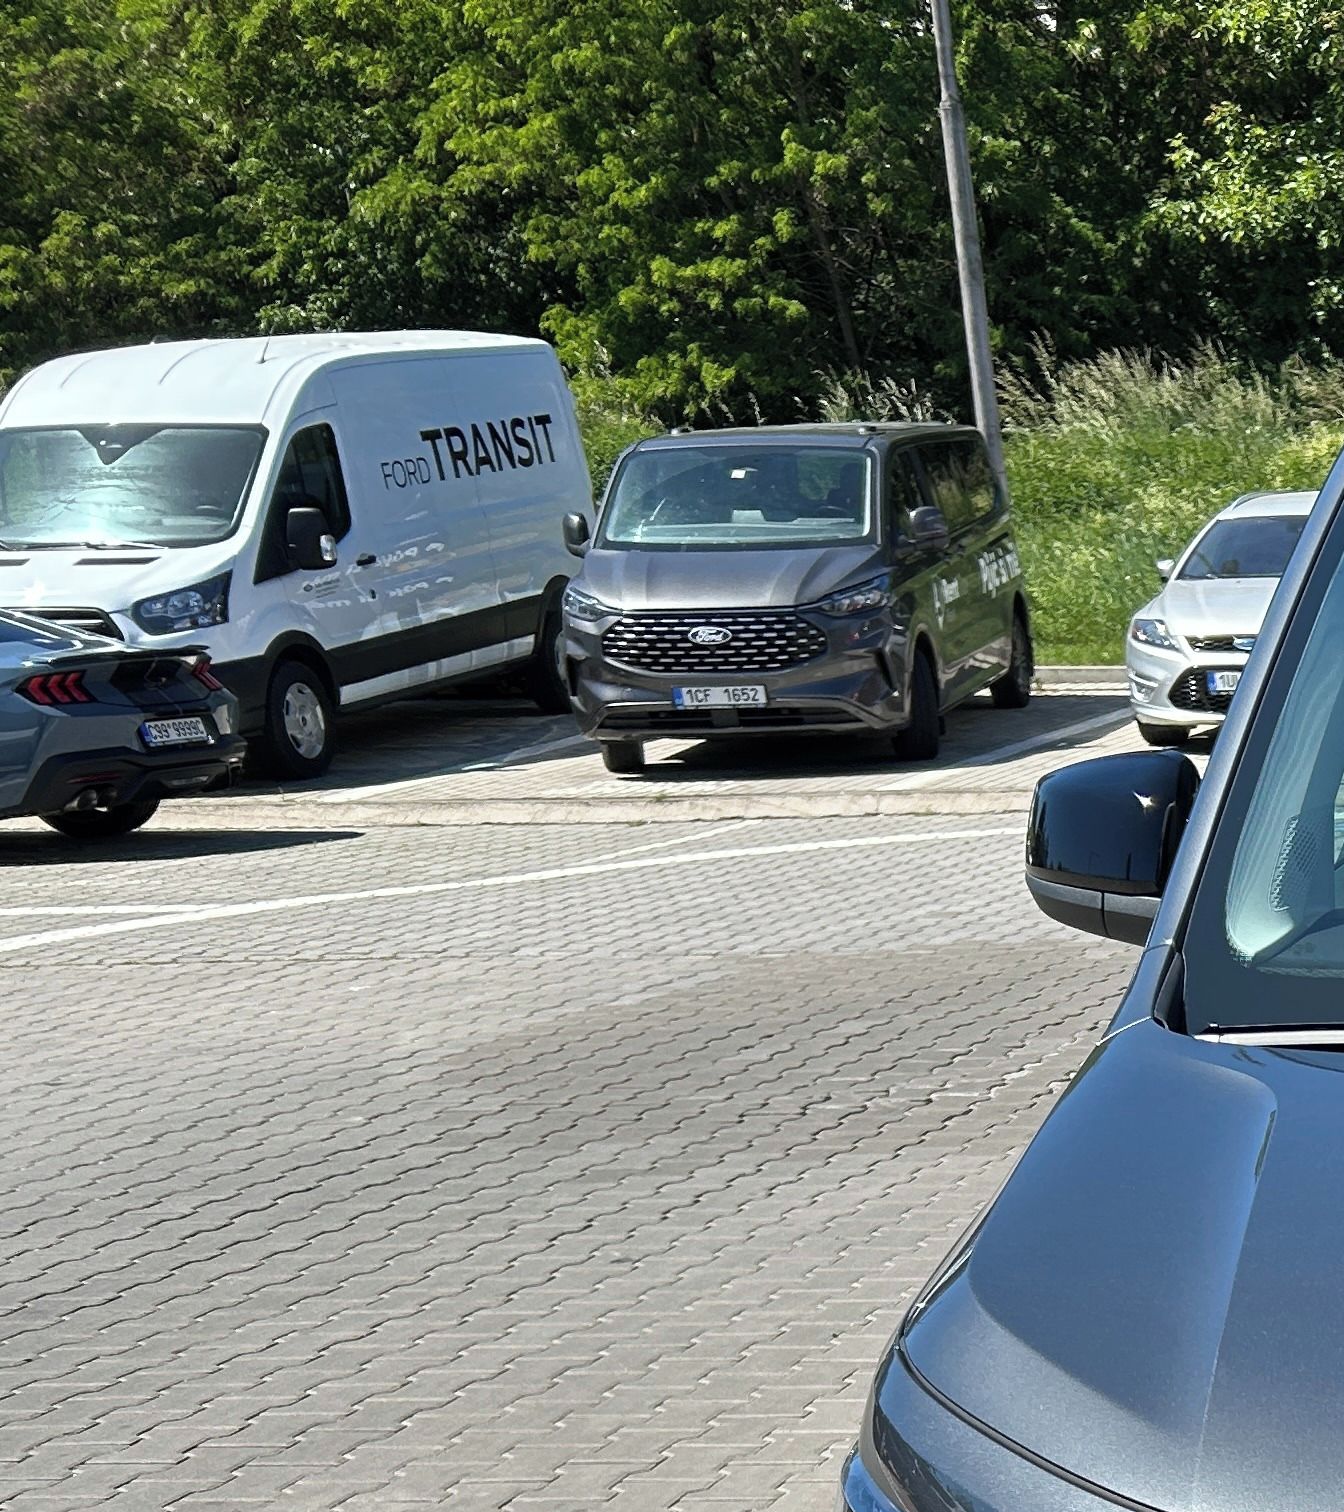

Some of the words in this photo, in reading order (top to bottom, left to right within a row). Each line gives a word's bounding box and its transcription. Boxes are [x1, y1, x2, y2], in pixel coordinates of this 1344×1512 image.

[380, 456, 431, 490] FORD
[420, 413, 556, 481] TRANSIT
[723, 687, 760, 702] 1652
